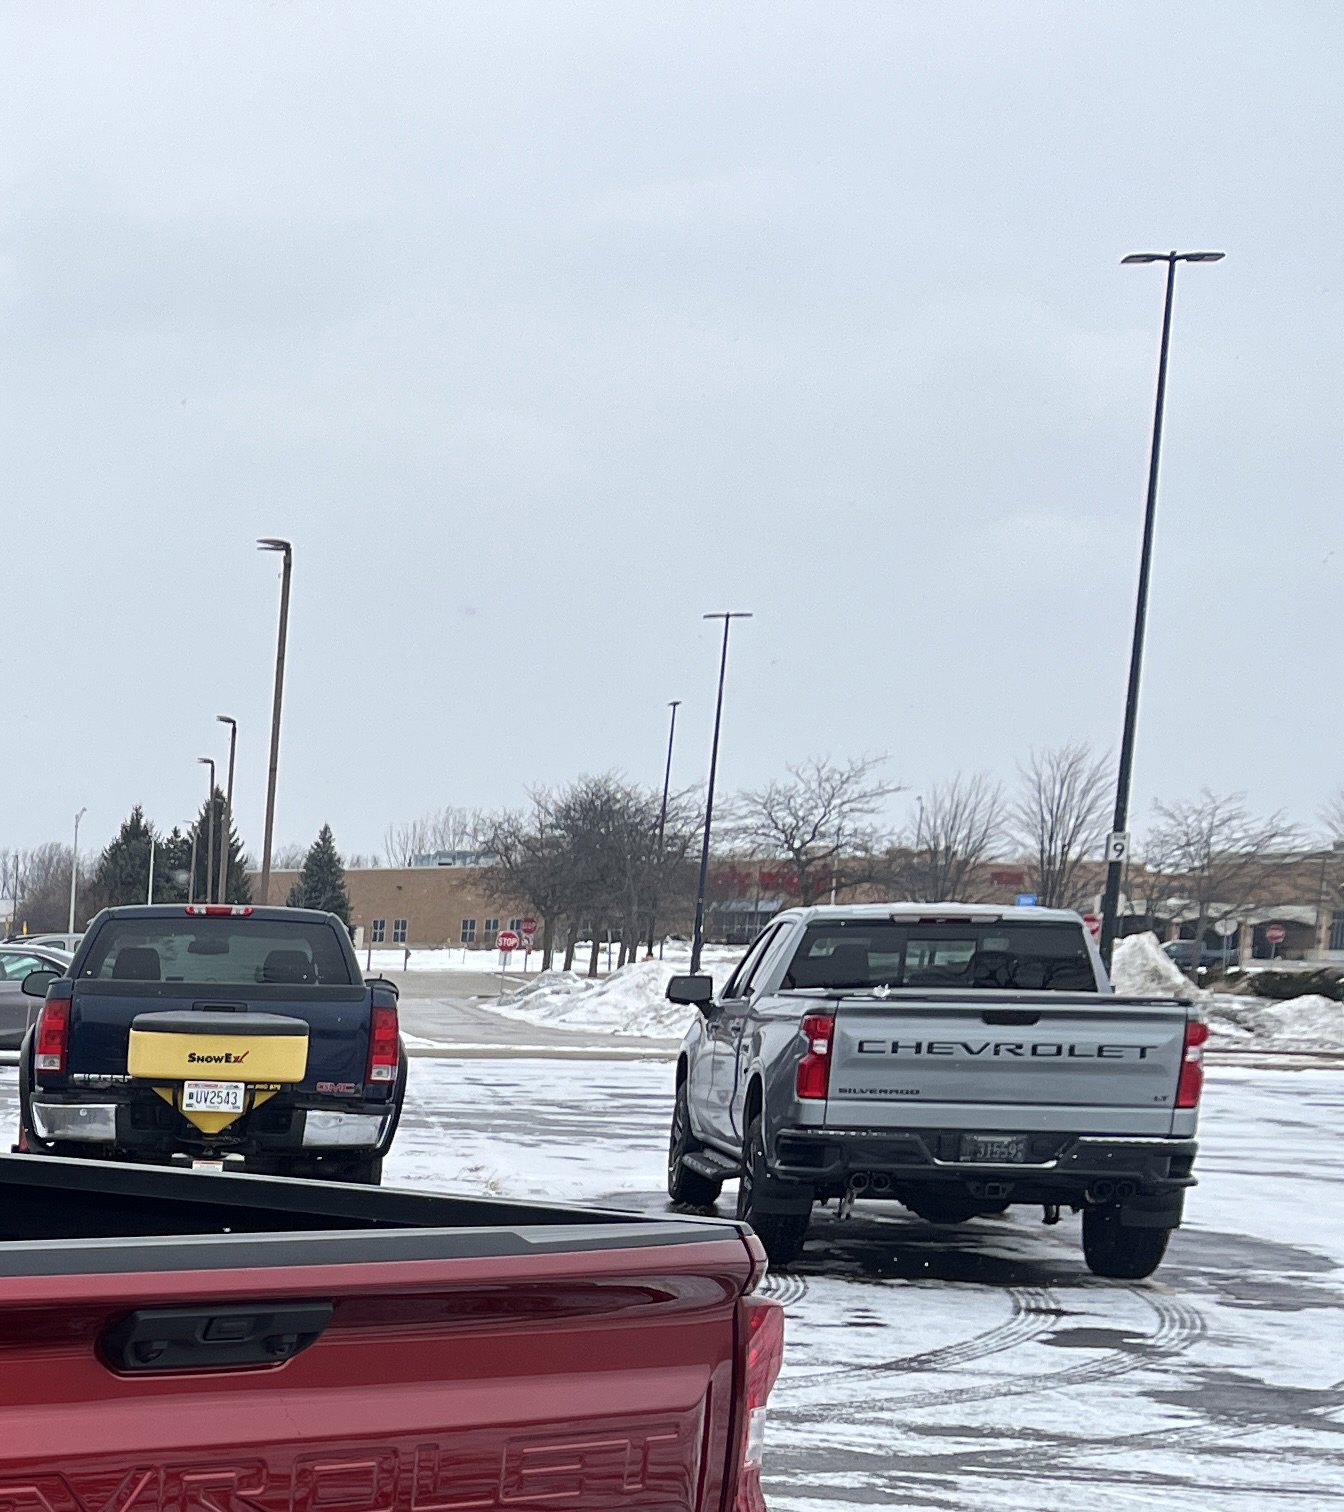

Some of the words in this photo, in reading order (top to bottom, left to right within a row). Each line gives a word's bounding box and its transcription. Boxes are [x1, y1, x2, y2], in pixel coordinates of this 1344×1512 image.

[498, 938, 518, 946] STOP
[857, 1039, 1160, 1060] CHEVROLET
[316, 1081, 356, 1094] GMC
[838, 1087, 921, 1096] SILVERADO
